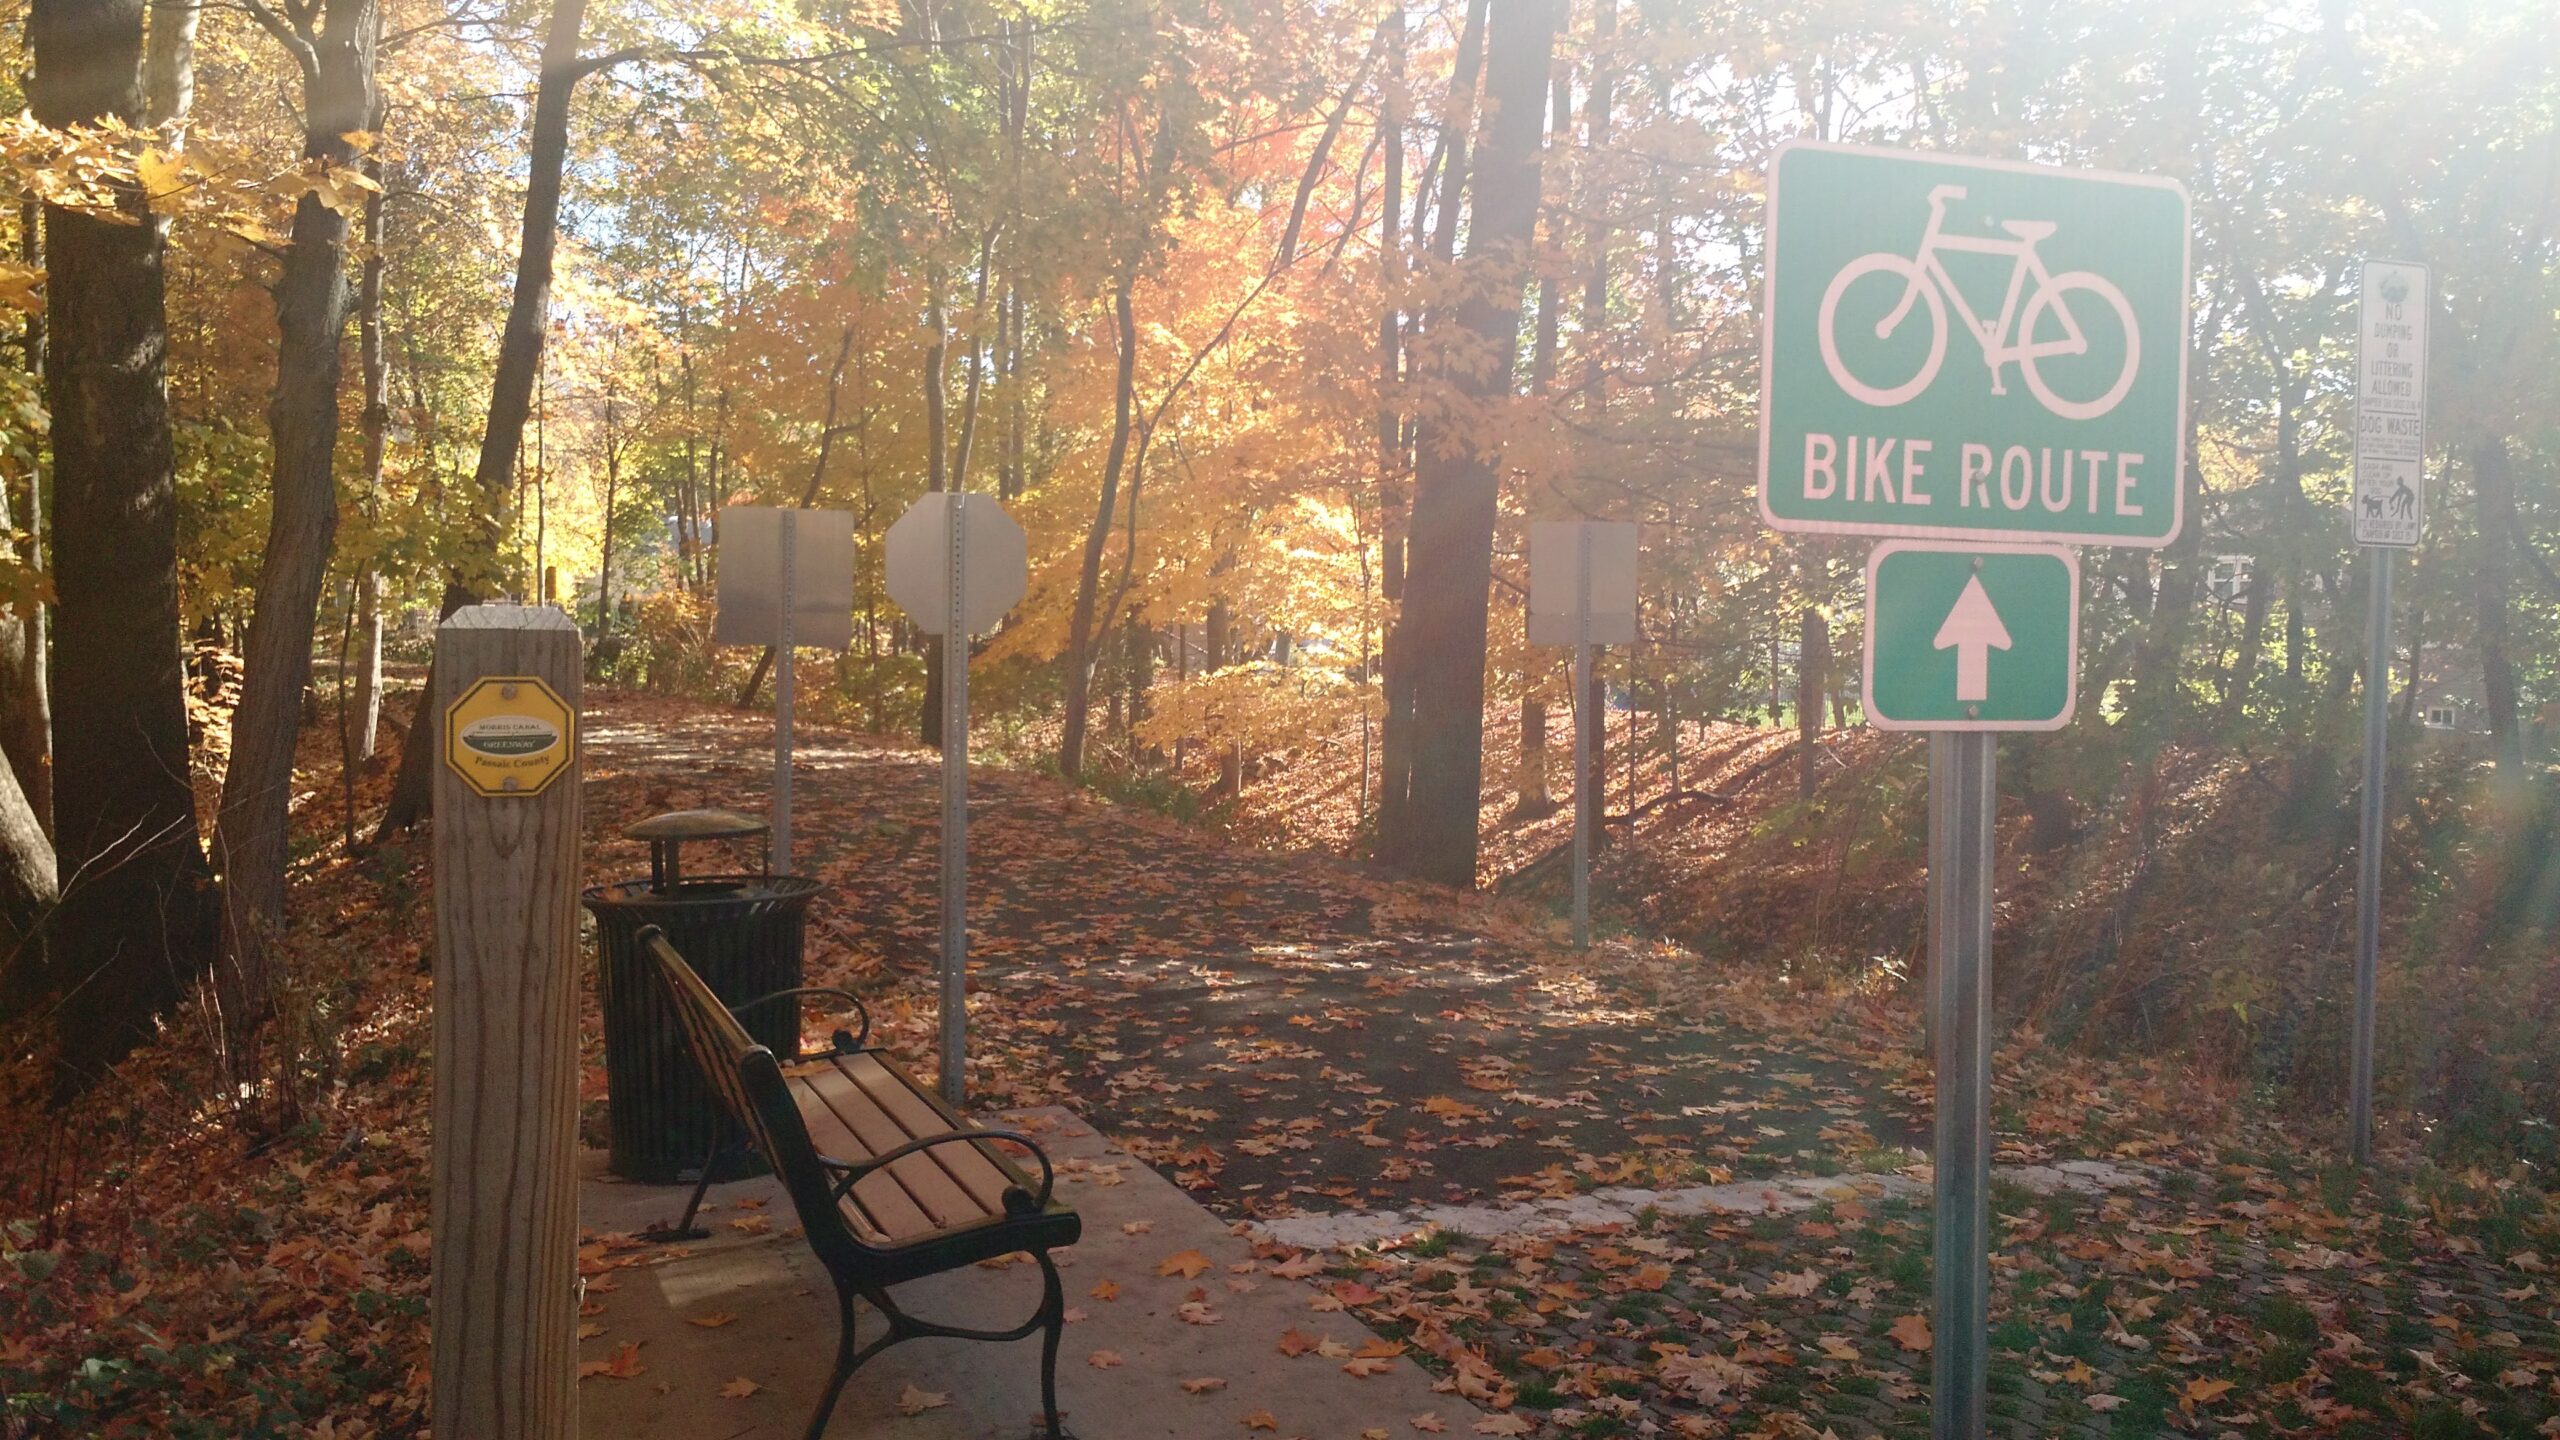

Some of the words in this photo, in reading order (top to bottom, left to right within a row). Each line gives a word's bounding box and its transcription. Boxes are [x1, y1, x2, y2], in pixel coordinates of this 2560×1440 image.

[2385, 303, 2402, 321] NO
[2374, 323, 2412, 341] DUMPING
[2386, 342, 2399, 358] OR
[2371, 360, 2413, 378] LITTERING
[2371, 380, 2411, 397] ALLOWED
[2360, 415, 2382, 434] DOG
[2387, 417, 2420, 437] WASTE
[1803, 433, 1933, 506] BIKE
[1960, 443, 2145, 517] ROUTE
[475, 756, 511, 768] Passaic
[513, 755, 549, 768] County
